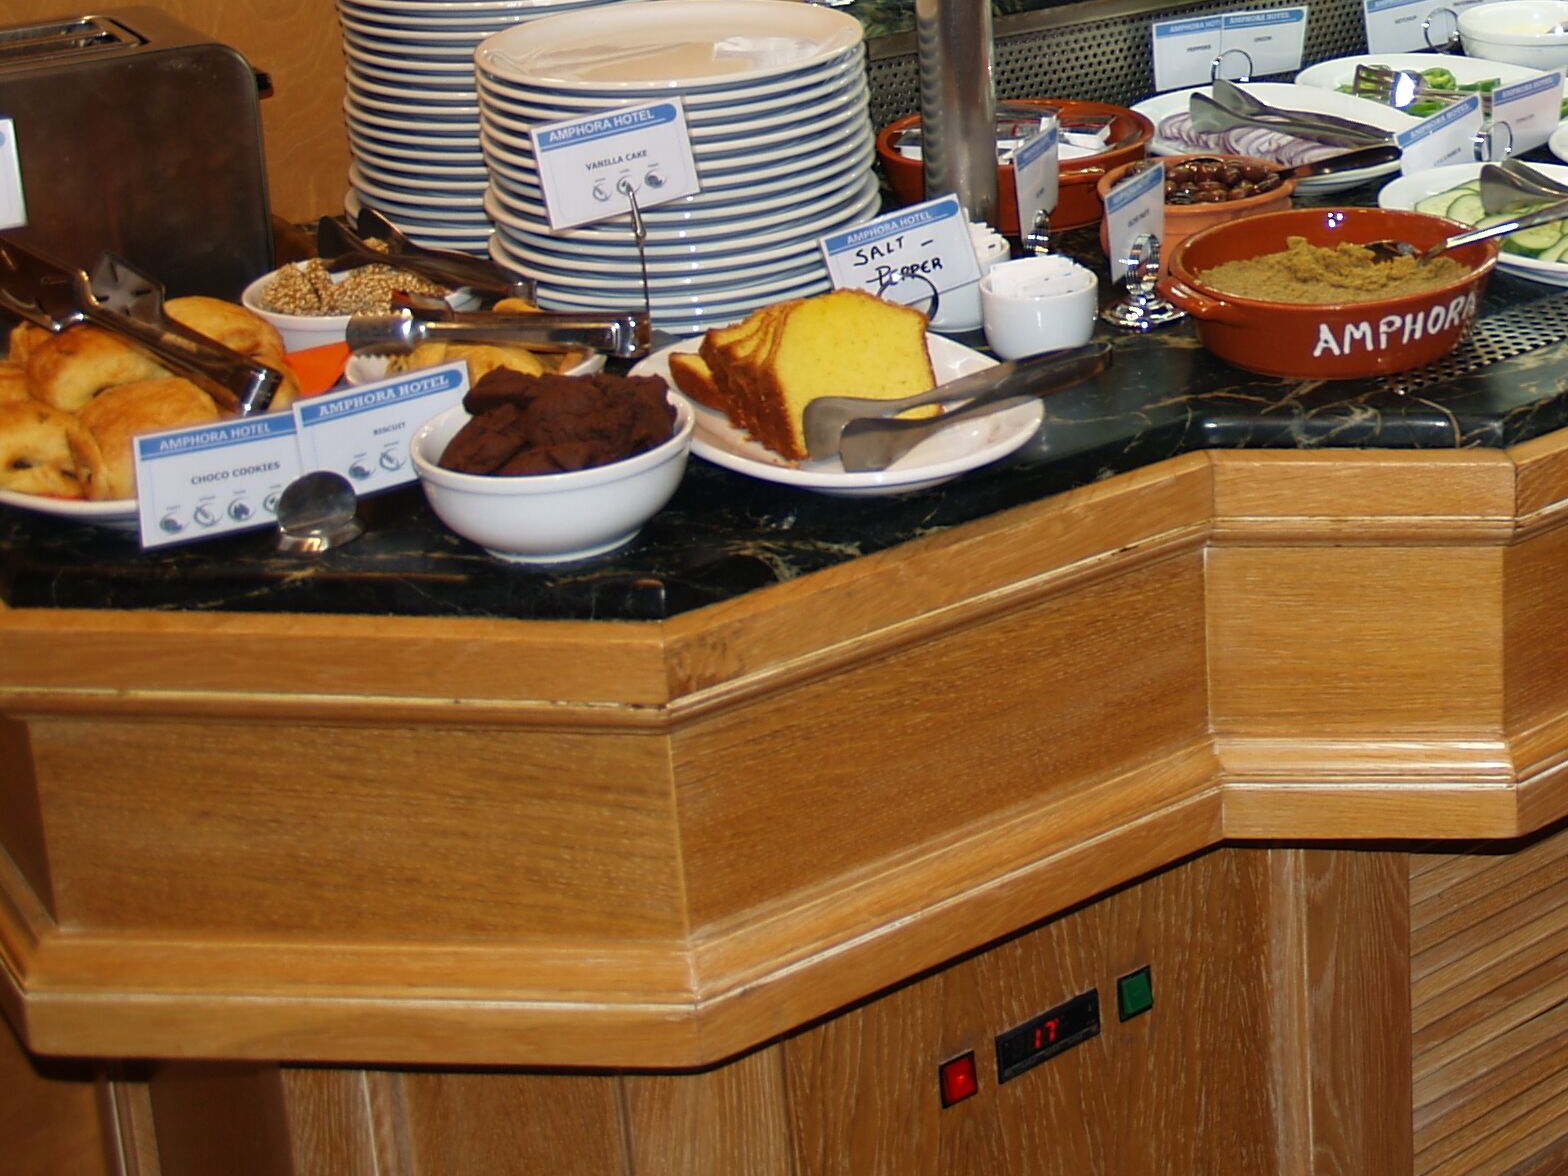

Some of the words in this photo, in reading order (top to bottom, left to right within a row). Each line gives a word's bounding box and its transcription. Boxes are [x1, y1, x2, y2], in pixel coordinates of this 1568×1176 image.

[550, 119, 612, 143] AMPHORA
[614, 109, 655, 127] HOTEL
[586, 156, 624, 171] VANILLA
[625, 150, 647, 162] CAKE
[847, 222, 899, 245] AMPHORA
[900, 211, 933, 227] HOTEL
[853, 236, 904, 266] SALT
[1313, 291, 1477, 357] AMPHORA
[318, 386, 397, 418] AMPHORA
[398, 375, 450, 397] HOTEL
[159, 430, 229, 452] AMPHORA
[230, 423, 271, 439] HOTEL
[373, 421, 407, 436] BISCUIT
[190, 472, 230, 485] CHOCO
[232, 461, 281, 478] COOKIES
